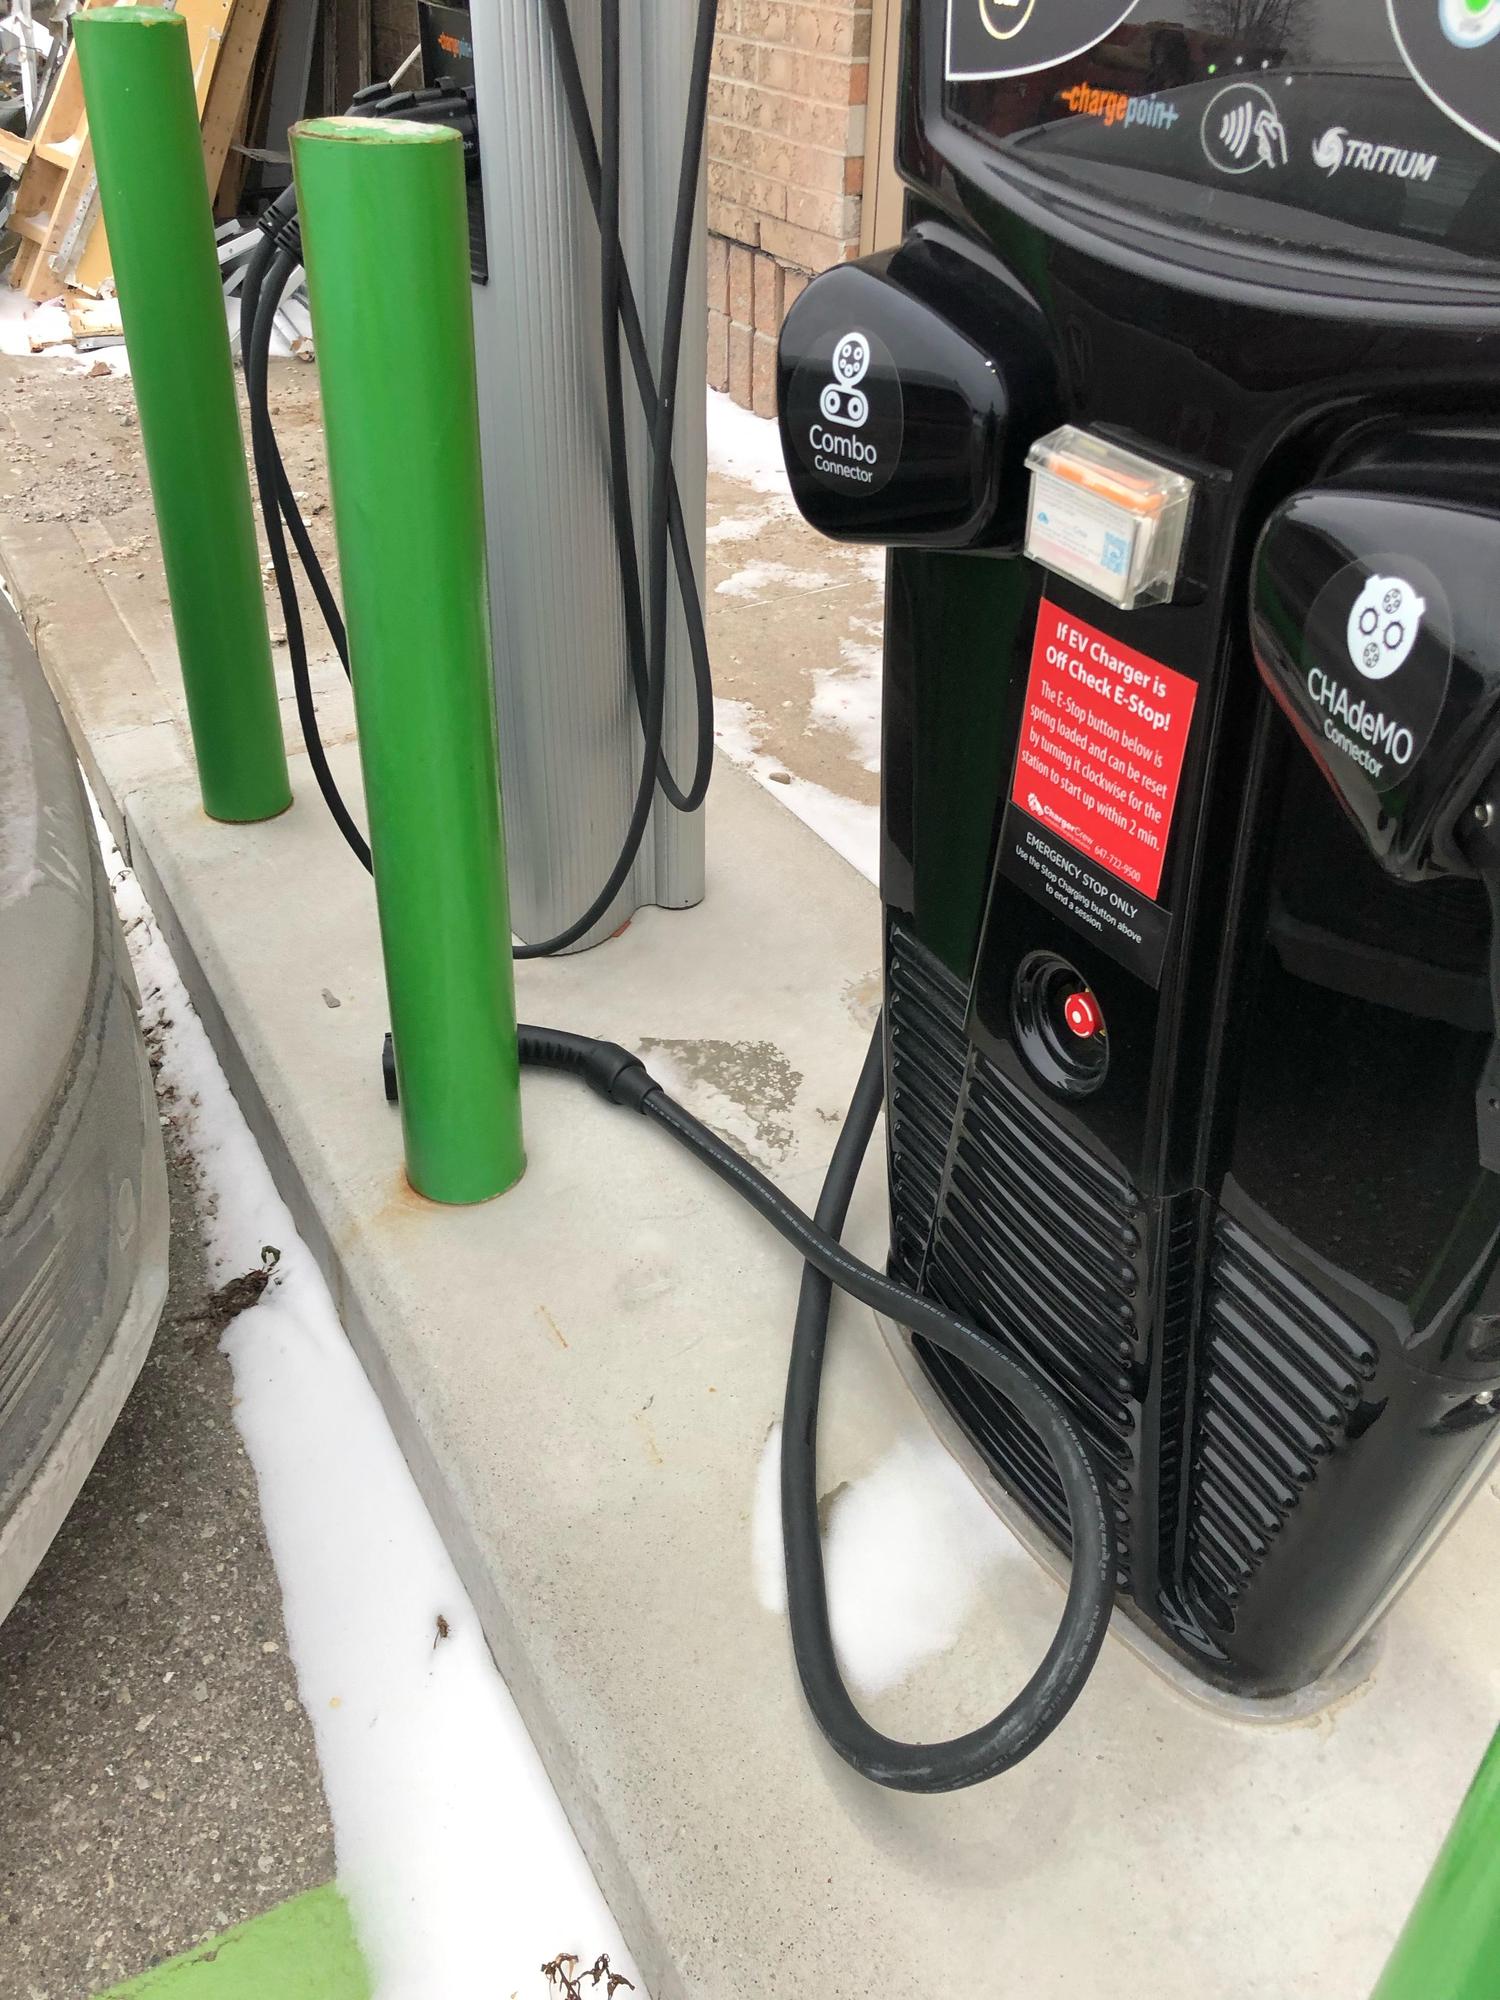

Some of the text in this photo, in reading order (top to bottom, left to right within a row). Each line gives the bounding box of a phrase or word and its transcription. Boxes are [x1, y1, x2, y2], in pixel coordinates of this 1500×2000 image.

[1344, 139, 1438, 182] TRITIUM
[809, 424, 877, 465] Combo
[814, 454, 873, 483] Connector
[1046, 646, 1171, 731] Off Check E-Stop!
[1056, 622, 1166, 697] If EV Charger is
[1030, 704, 1167, 800] spring loaded and can be reset
[1041, 680, 1163, 769] The E-Stop button below is
[1307, 667, 1414, 765] CHAdeMO
[1323, 718, 1384, 778] Connector
[1021, 750, 1160, 852] station to start up within 2 min.
[1029, 726, 1162, 824] by turning it clockwise for the
[1015, 844, 1142, 944] Use the Stop Charging button above
[1026, 832, 1081, 879] EMERGENCY
[1081, 873, 1108, 897] STOP
[1109, 893, 1138, 919] ONLY
[1045, 883, 1103, 932] to end a session.
